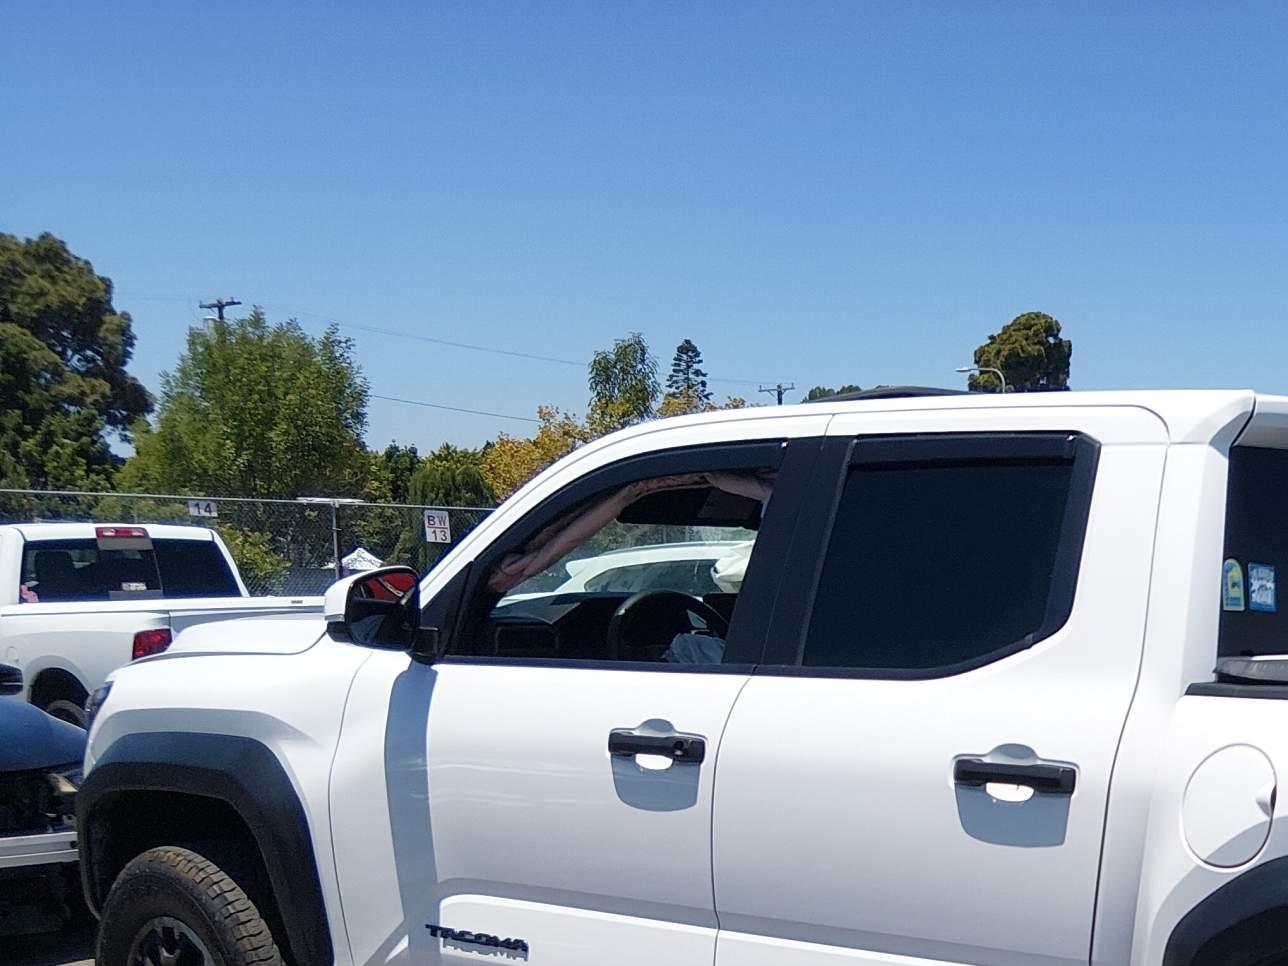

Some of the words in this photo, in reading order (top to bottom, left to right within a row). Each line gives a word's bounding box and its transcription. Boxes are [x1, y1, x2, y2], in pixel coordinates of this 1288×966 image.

[194, 502, 213, 516] 14
[431, 529, 448, 542] 13
[425, 924, 529, 953] TACOMA
